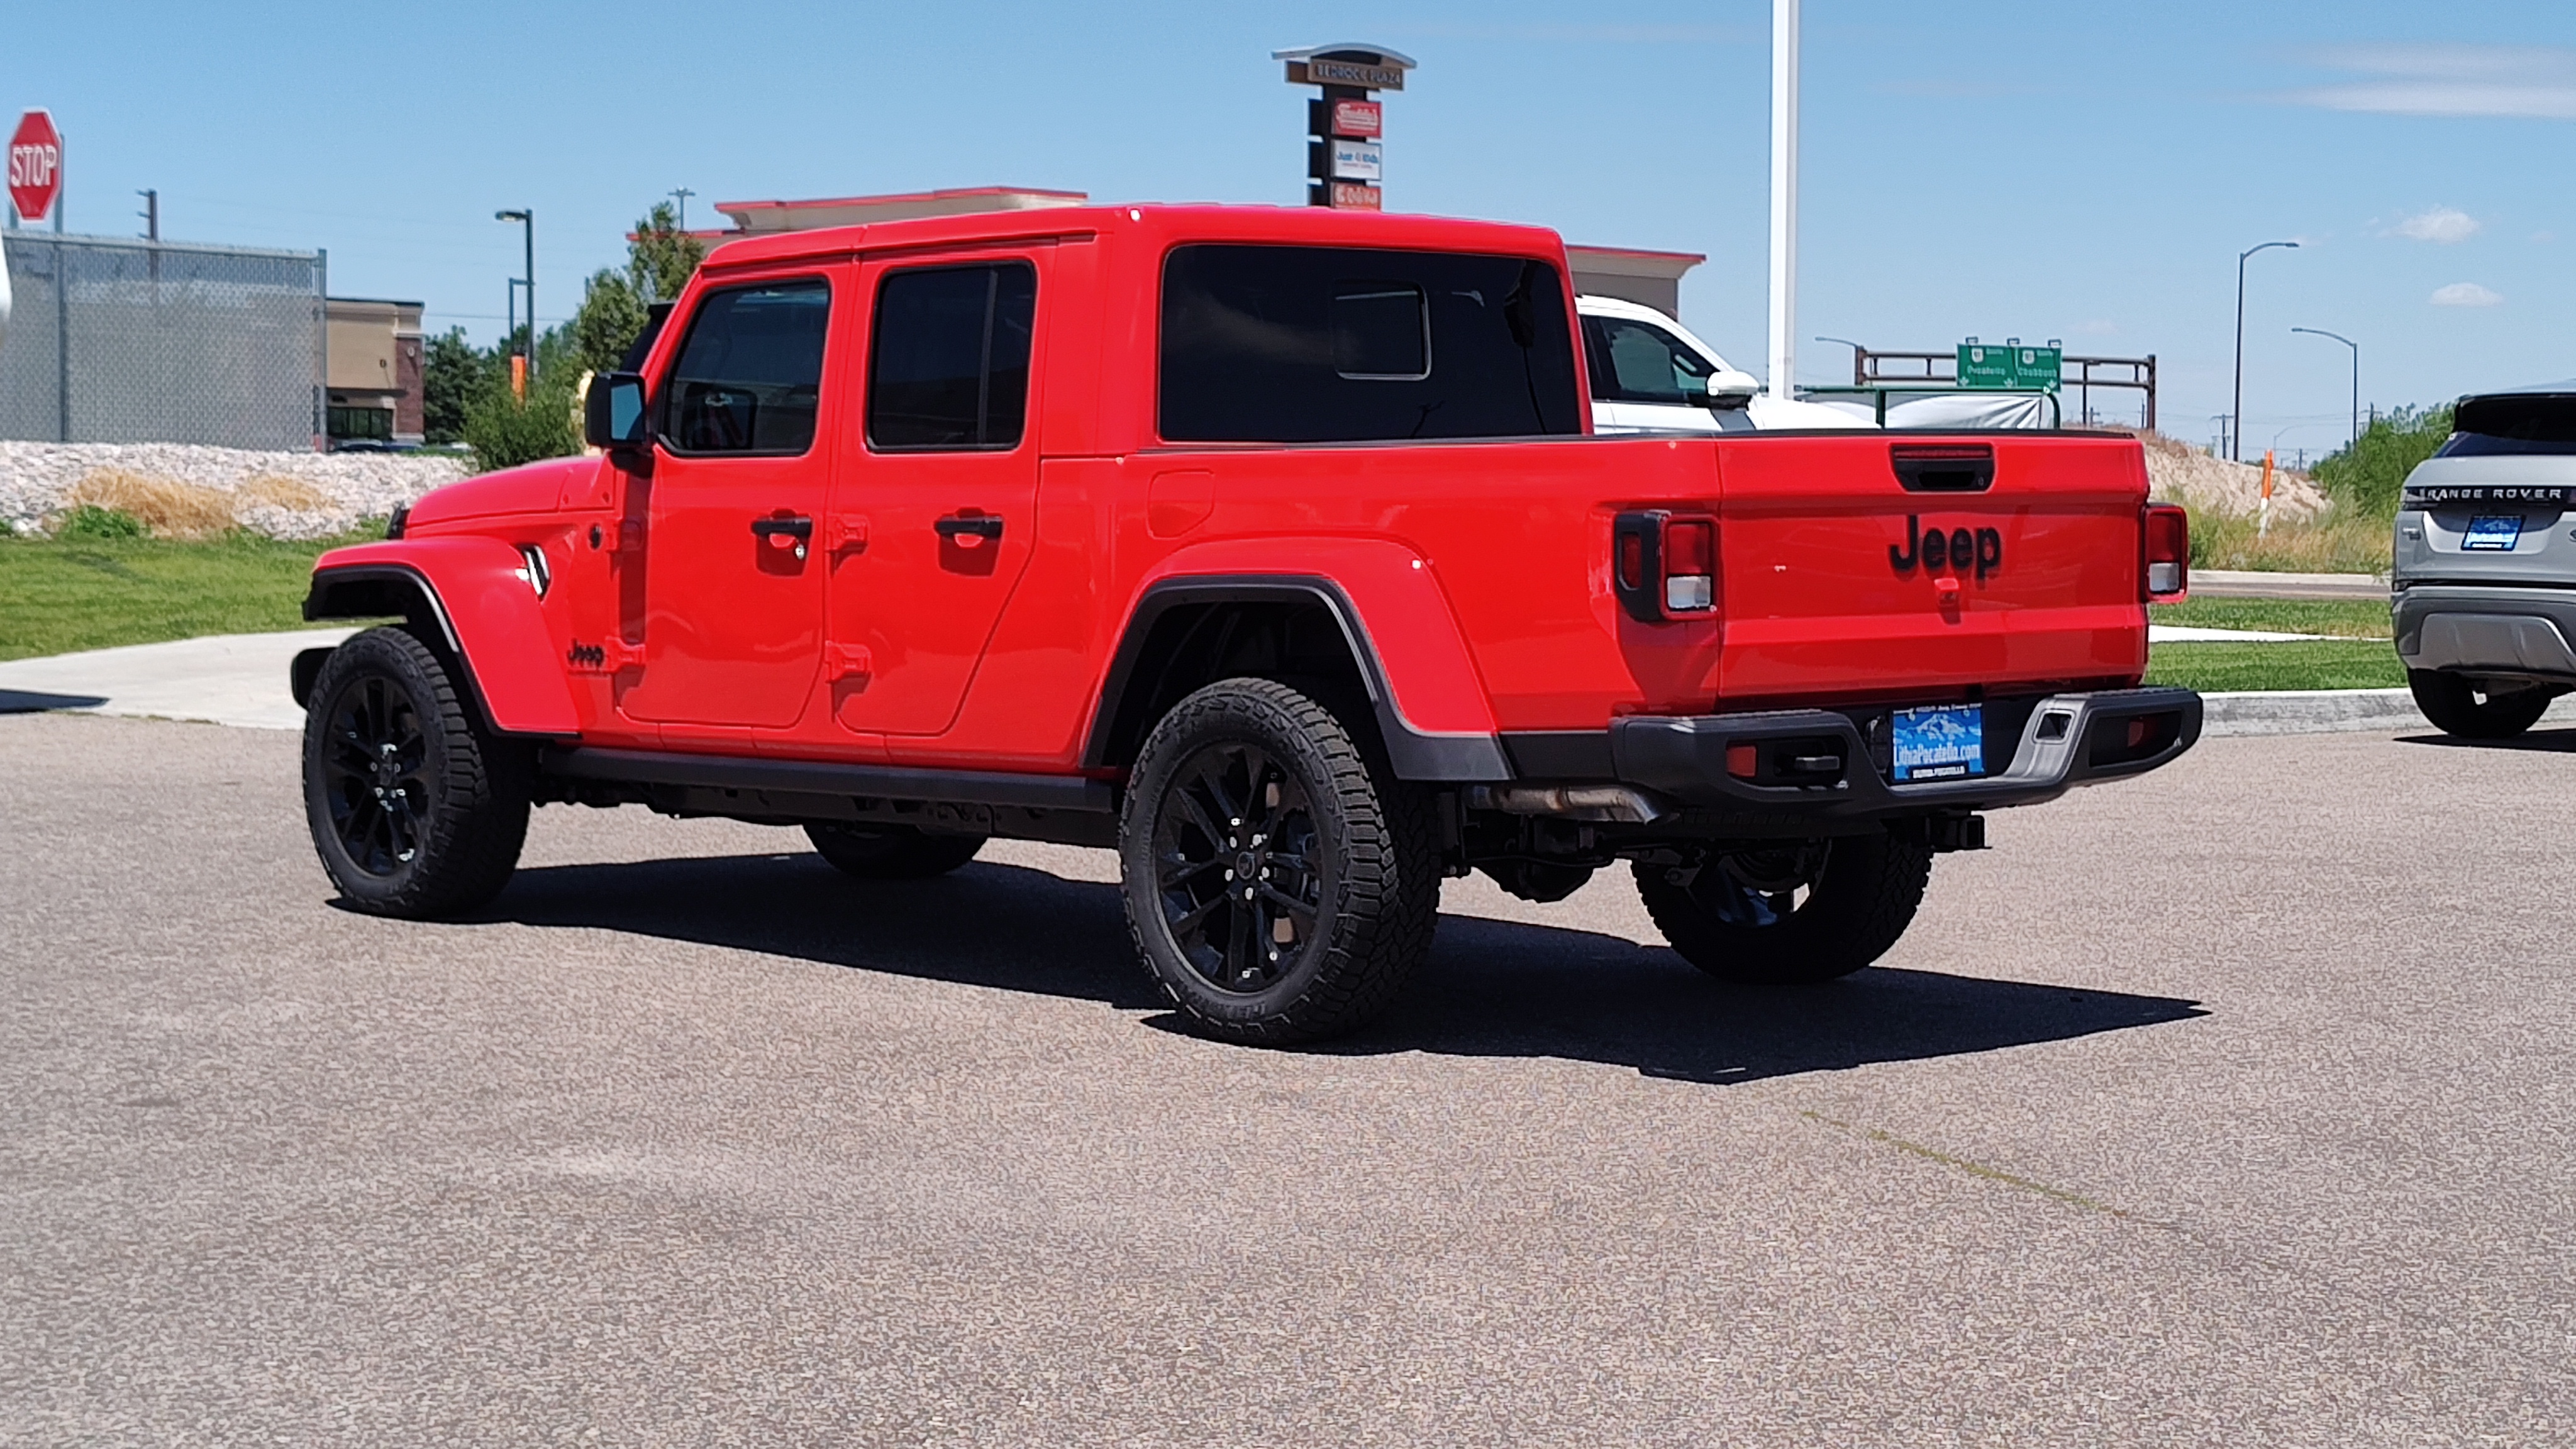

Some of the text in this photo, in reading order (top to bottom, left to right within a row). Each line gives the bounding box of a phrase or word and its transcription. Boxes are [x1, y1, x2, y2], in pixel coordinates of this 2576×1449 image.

[1370, 69, 1401, 84] PLAZA
[11, 145, 57, 187] STOP
[2428, 489, 2562, 500] RANGE ROVER
[1889, 514, 2002, 580] Jeep
[567, 638, 604, 667] Jeep
